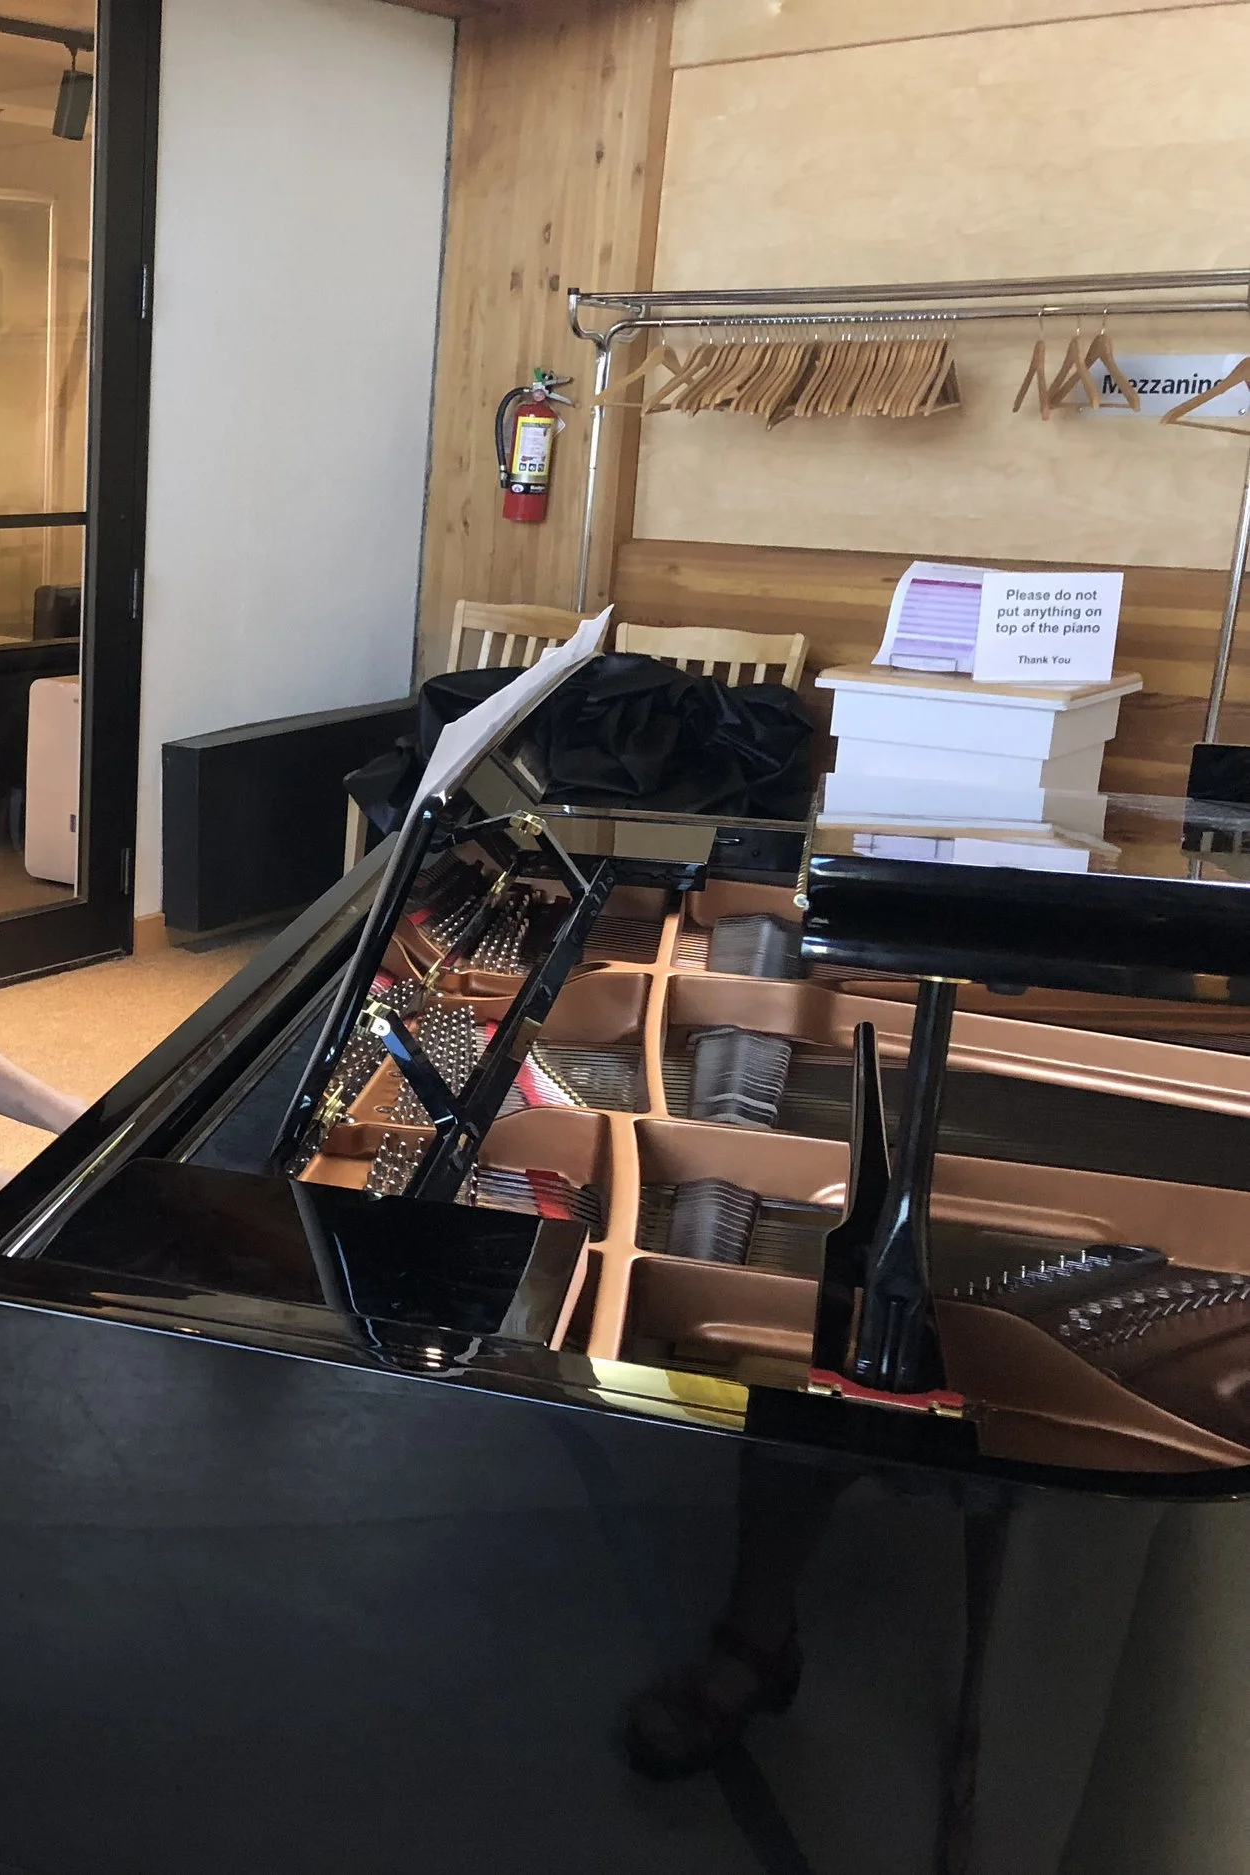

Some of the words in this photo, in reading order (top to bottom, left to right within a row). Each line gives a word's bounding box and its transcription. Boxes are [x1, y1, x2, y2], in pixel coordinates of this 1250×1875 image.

[1006, 589, 1051, 601] Please
[1054, 589, 1072, 601] do
[1075, 590, 1098, 601] not
[997, 607, 1020, 619] put
[1023, 605, 1081, 620] anything
[1085, 608, 1102, 617] on
[996, 622, 1017, 635] top
[1021, 622, 1036, 634] of
[1038, 622, 1059, 634] the
[1062, 622, 1101, 636] piano
[1018, 655, 1048, 665] Thank
[1051, 655, 1071, 665] You
